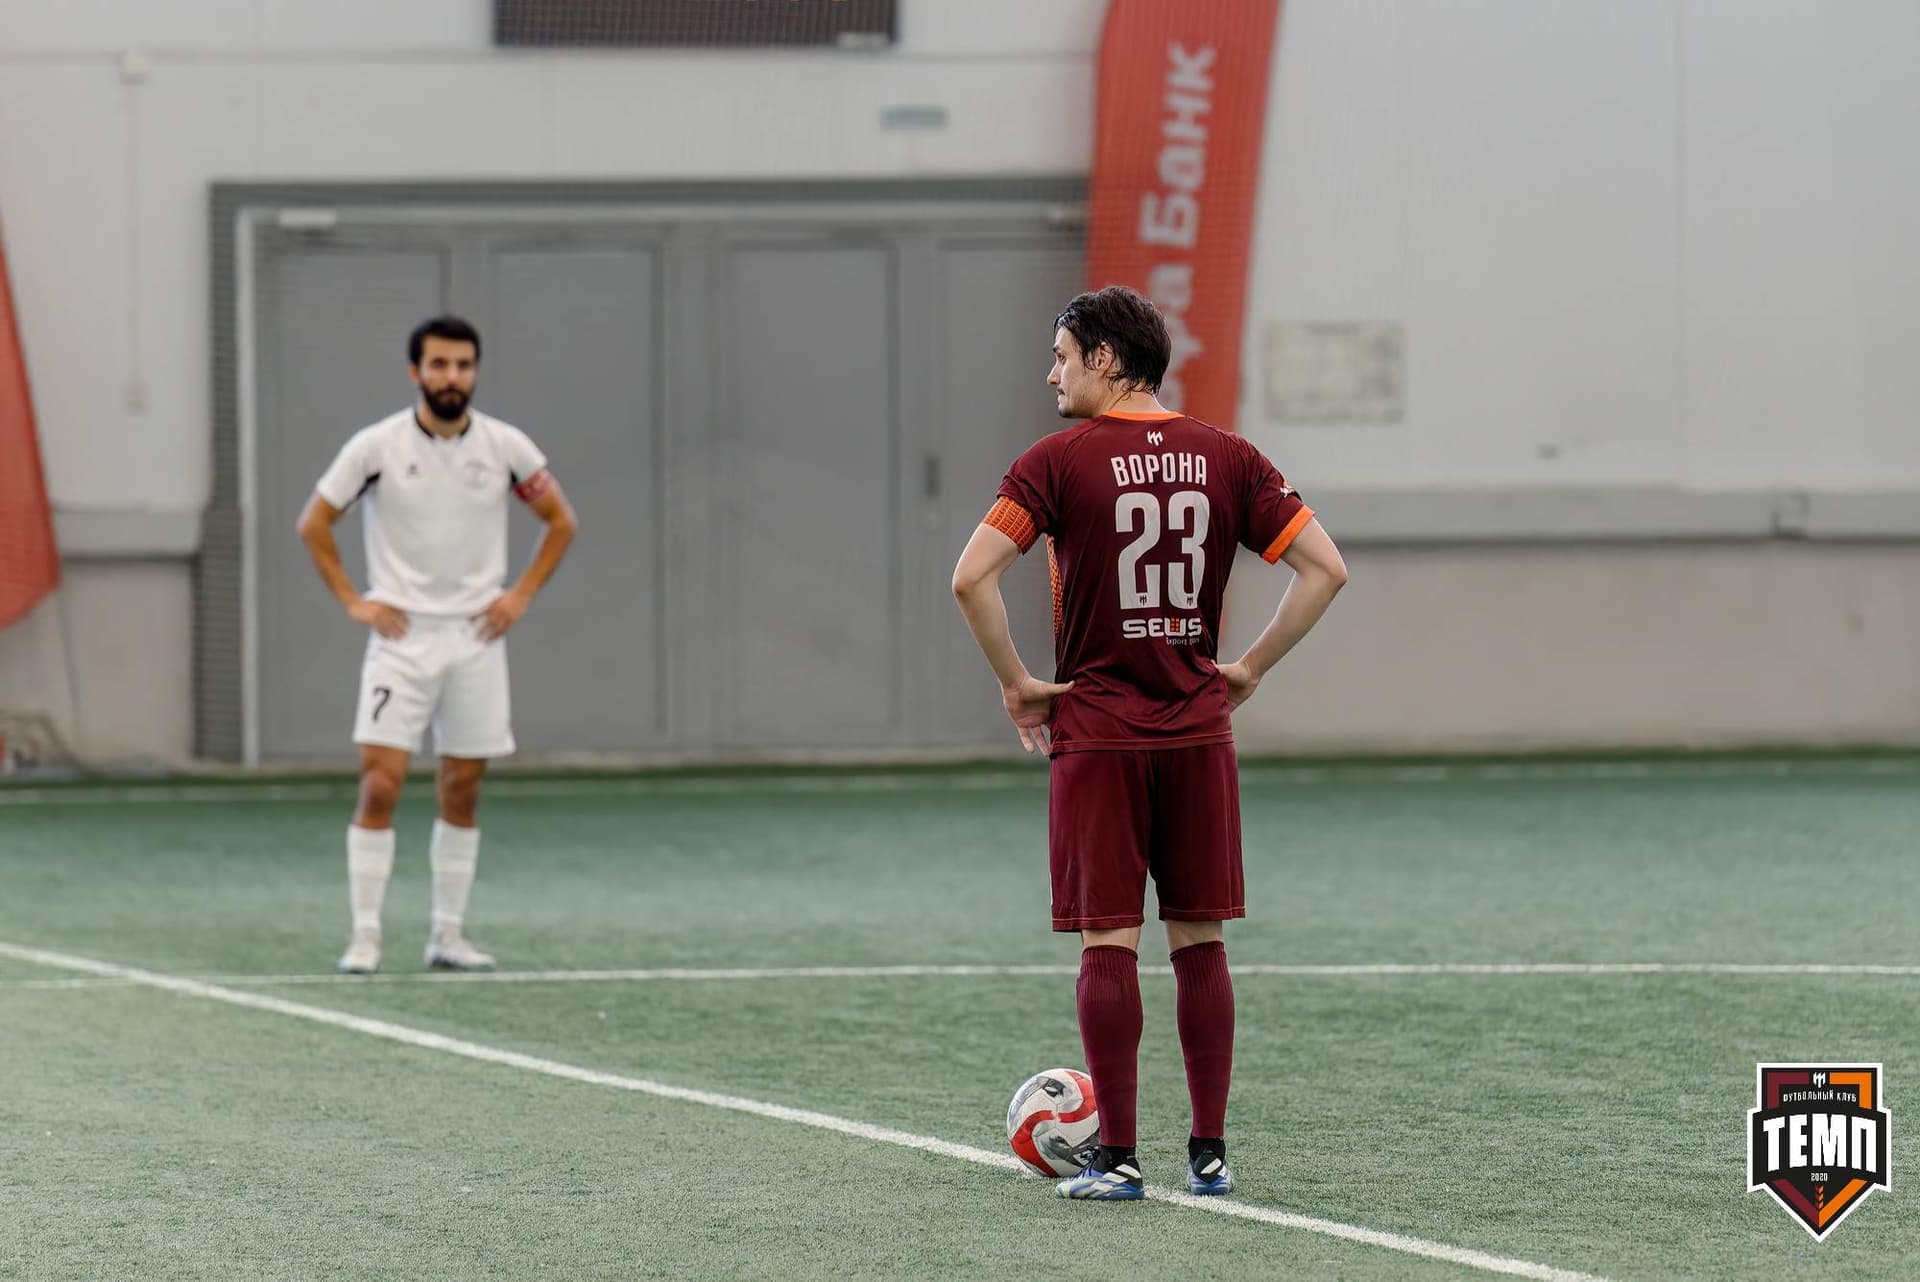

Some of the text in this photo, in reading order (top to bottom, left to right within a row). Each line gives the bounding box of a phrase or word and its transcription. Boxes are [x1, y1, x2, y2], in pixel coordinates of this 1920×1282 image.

[1137, 41, 1218, 249] Банк
[1111, 452, 1207, 487] ВОРОНА
[1115, 490, 1210, 609] 23
[1122, 617, 1203, 638] SEUS
[373, 686, 391, 722] 7
